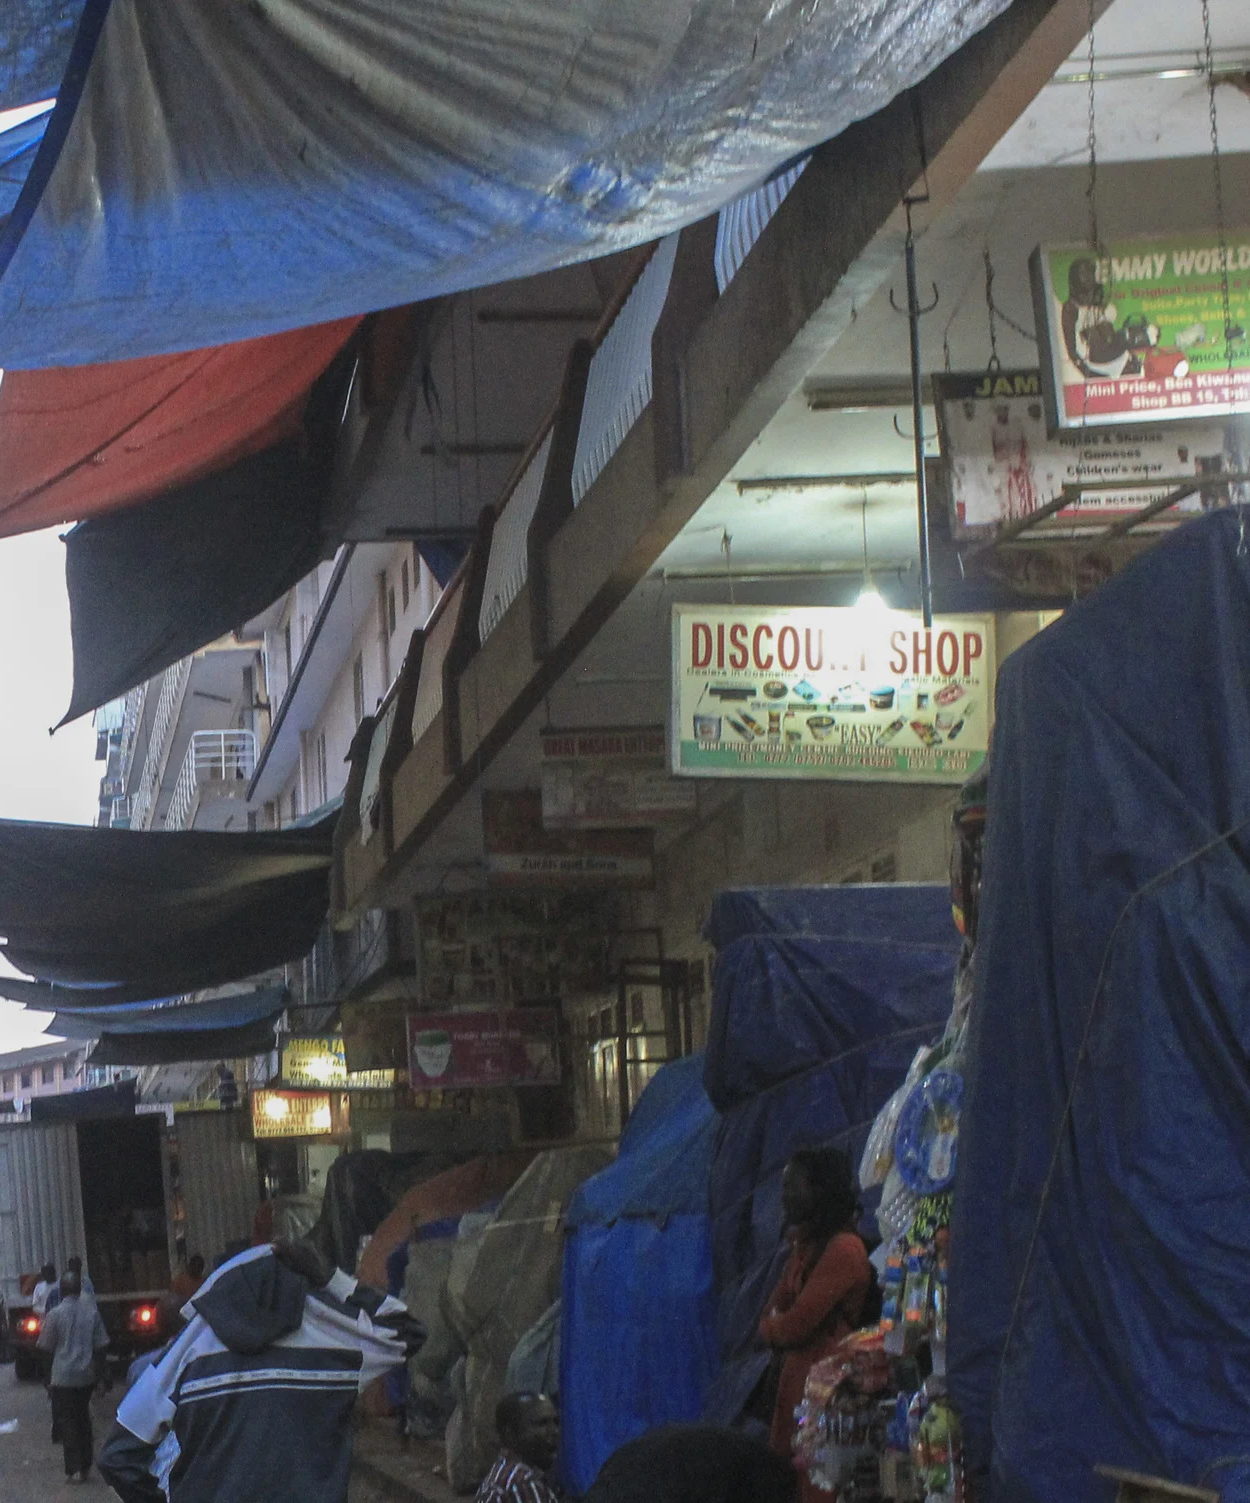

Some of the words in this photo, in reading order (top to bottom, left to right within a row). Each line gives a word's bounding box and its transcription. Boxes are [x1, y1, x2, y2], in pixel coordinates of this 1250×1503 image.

[1172, 245, 1250, 277] WORLD
[1086, 382, 1115, 399] Mini
[1119, 377, 1161, 395] Price,
[1131, 393, 1167, 410] Shop
[1067, 463, 1130, 476] Children's
[1132, 463, 1163, 474] wear
[888, 629, 983, 678] SHOP
[686, 666, 727, 677] Dealers
[743, 667, 799, 679] Cosmetics
[932, 676, 981, 686] Materials
[698, 741, 720, 751] MINI
